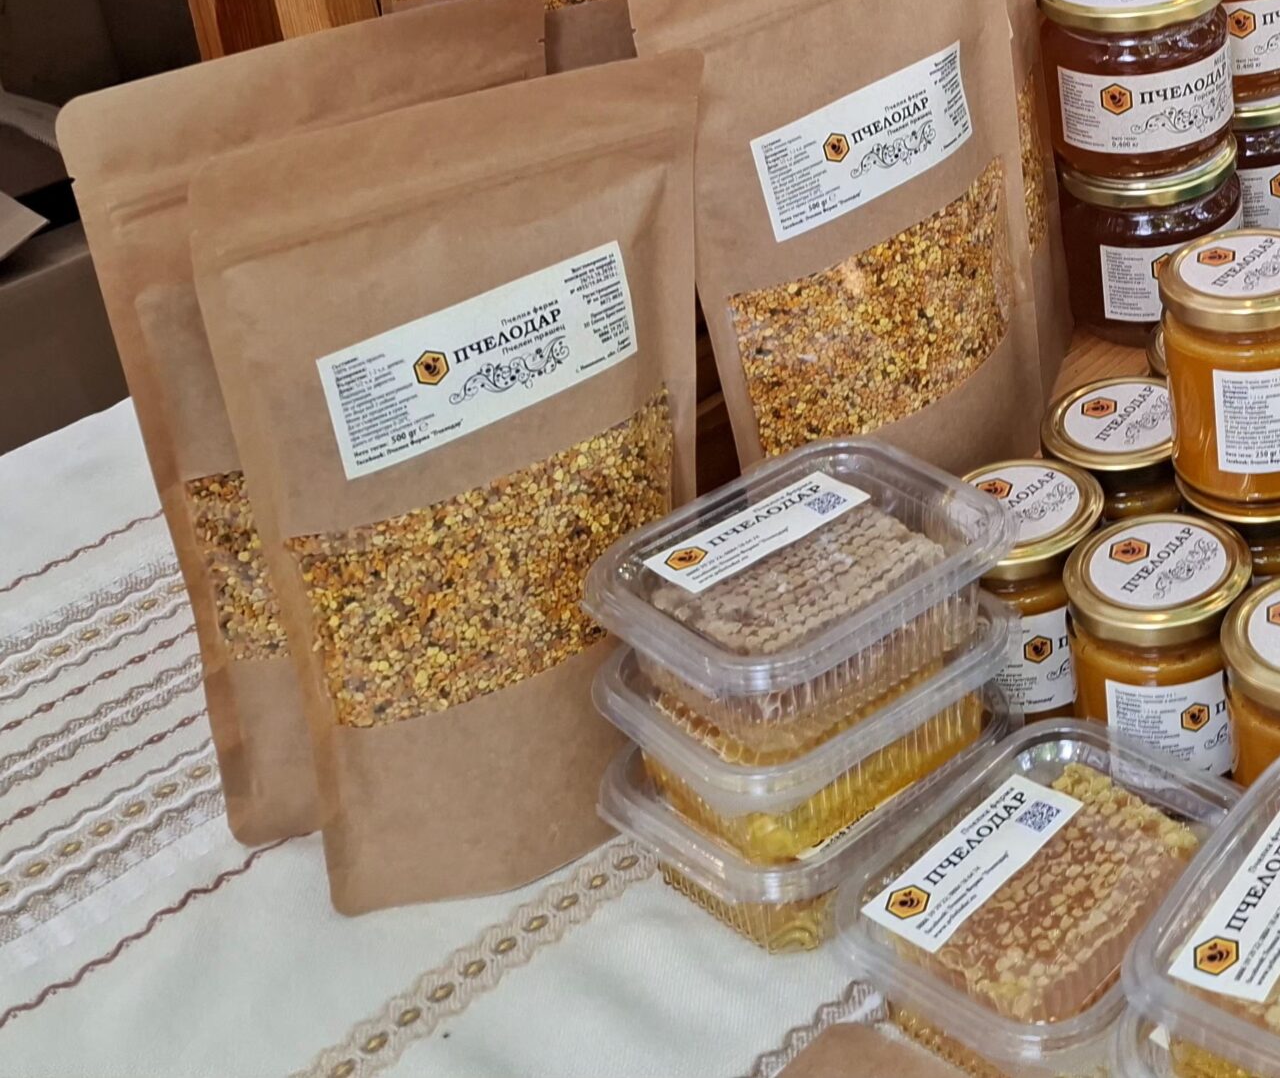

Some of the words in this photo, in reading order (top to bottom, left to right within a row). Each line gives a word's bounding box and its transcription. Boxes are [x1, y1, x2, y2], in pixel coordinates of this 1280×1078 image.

[1139, 60, 1228, 106] ПЧЕЛОДАР
[851, 96, 930, 145] ПЧЕЛОДАР
[1210, 237, 1276, 288] ПЧЕЛОДАР
[453, 307, 562, 365] ПЧЕЛОДАР
[501, 309, 531, 327] Пчелна
[532, 298, 559, 316] ферма
[501, 335, 532, 356] Пчелен
[533, 323, 566, 342] прашец
[391, 432, 407, 444] 500
[408, 428, 417, 440] gr
[1095, 385, 1155, 442] ПЧЕЛОДАР
[704, 483, 826, 547] ПЧЕЛОДАР
[1007, 471, 1057, 510] ЛОДАР
[1120, 526, 1194, 594] ПЧЕЛОДАР
[922, 791, 1032, 886] ПЧЕЛОДАР
